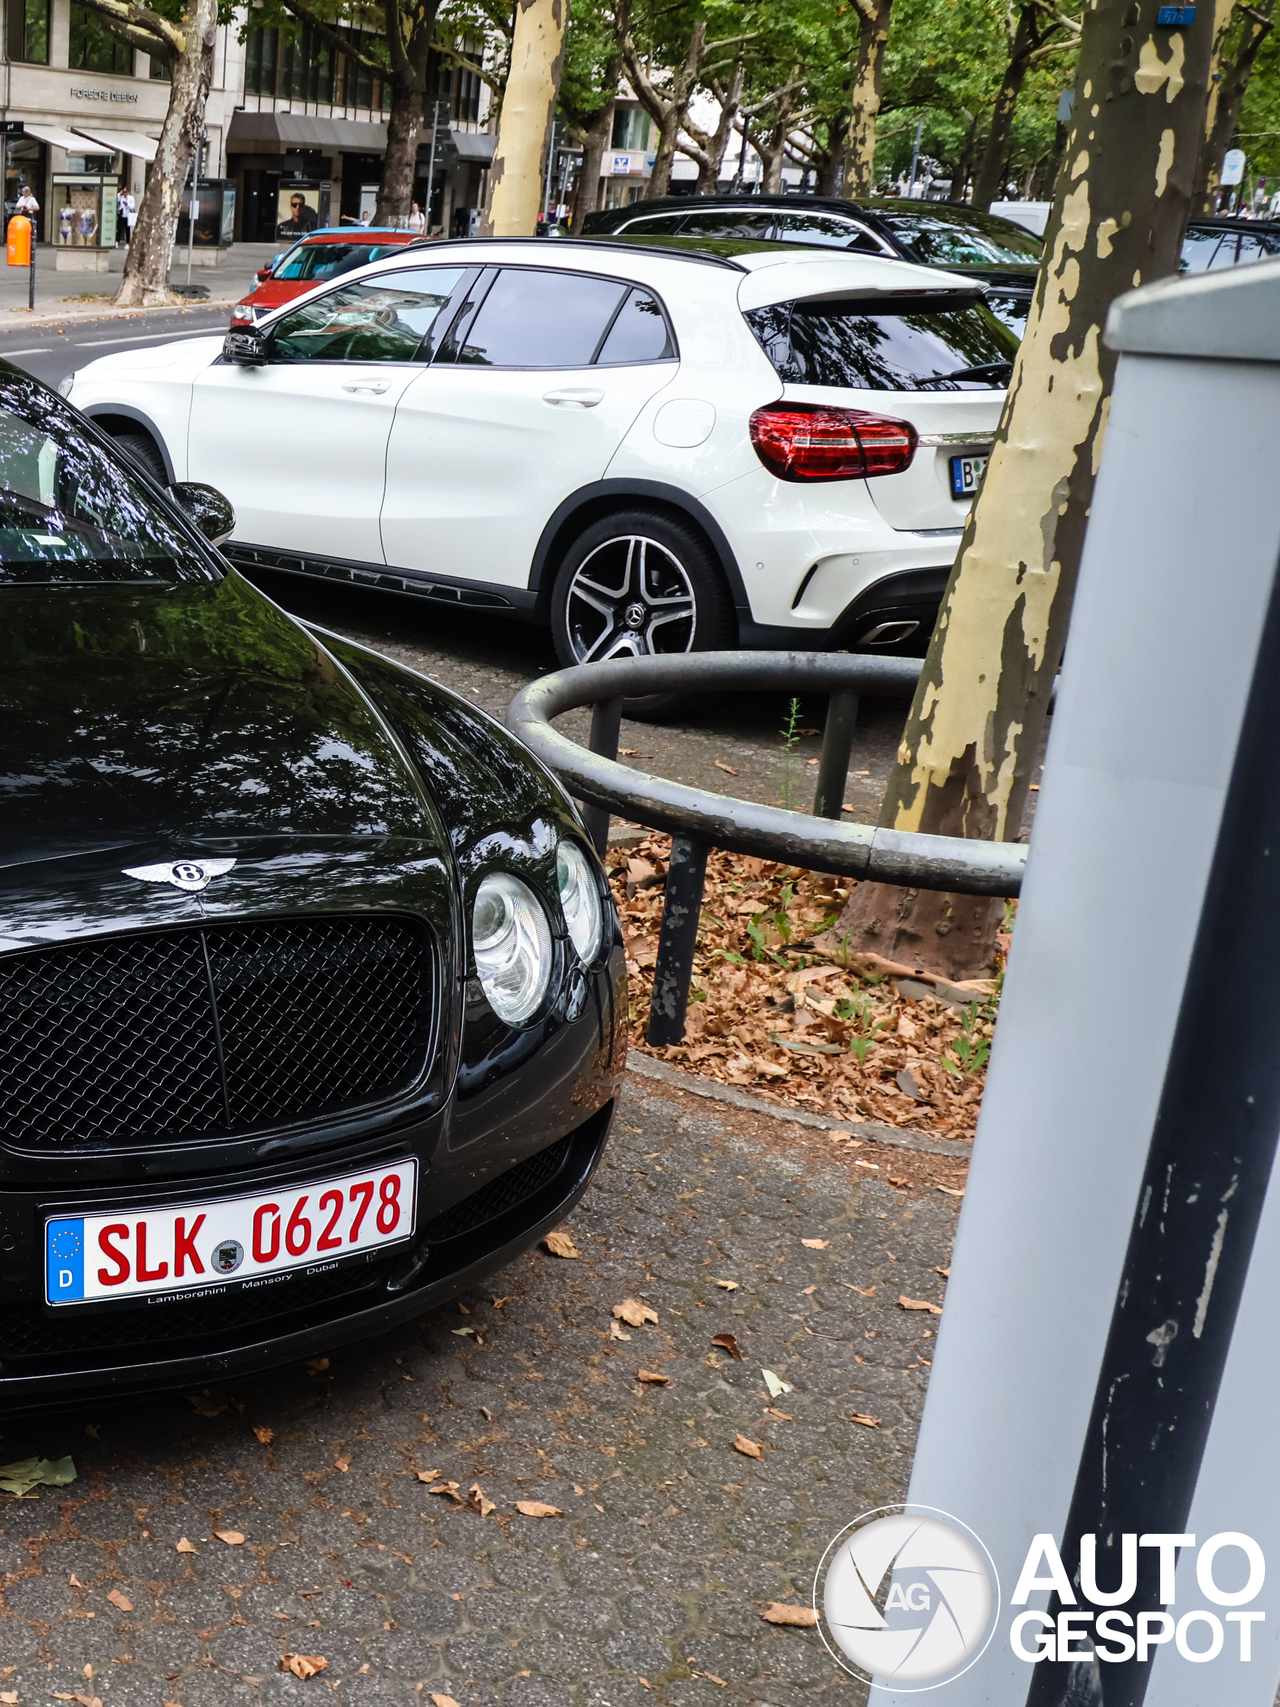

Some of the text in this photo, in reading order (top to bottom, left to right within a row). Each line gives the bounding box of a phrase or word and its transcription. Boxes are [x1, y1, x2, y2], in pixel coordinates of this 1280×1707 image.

[71, 87, 139, 103] PORSCHE DESIGN
[963, 461, 974, 488] B
[59, 1173, 401, 1288] D SLK 06278
[147, 1262, 339, 1305] Lamborghini Mansory Dubai
